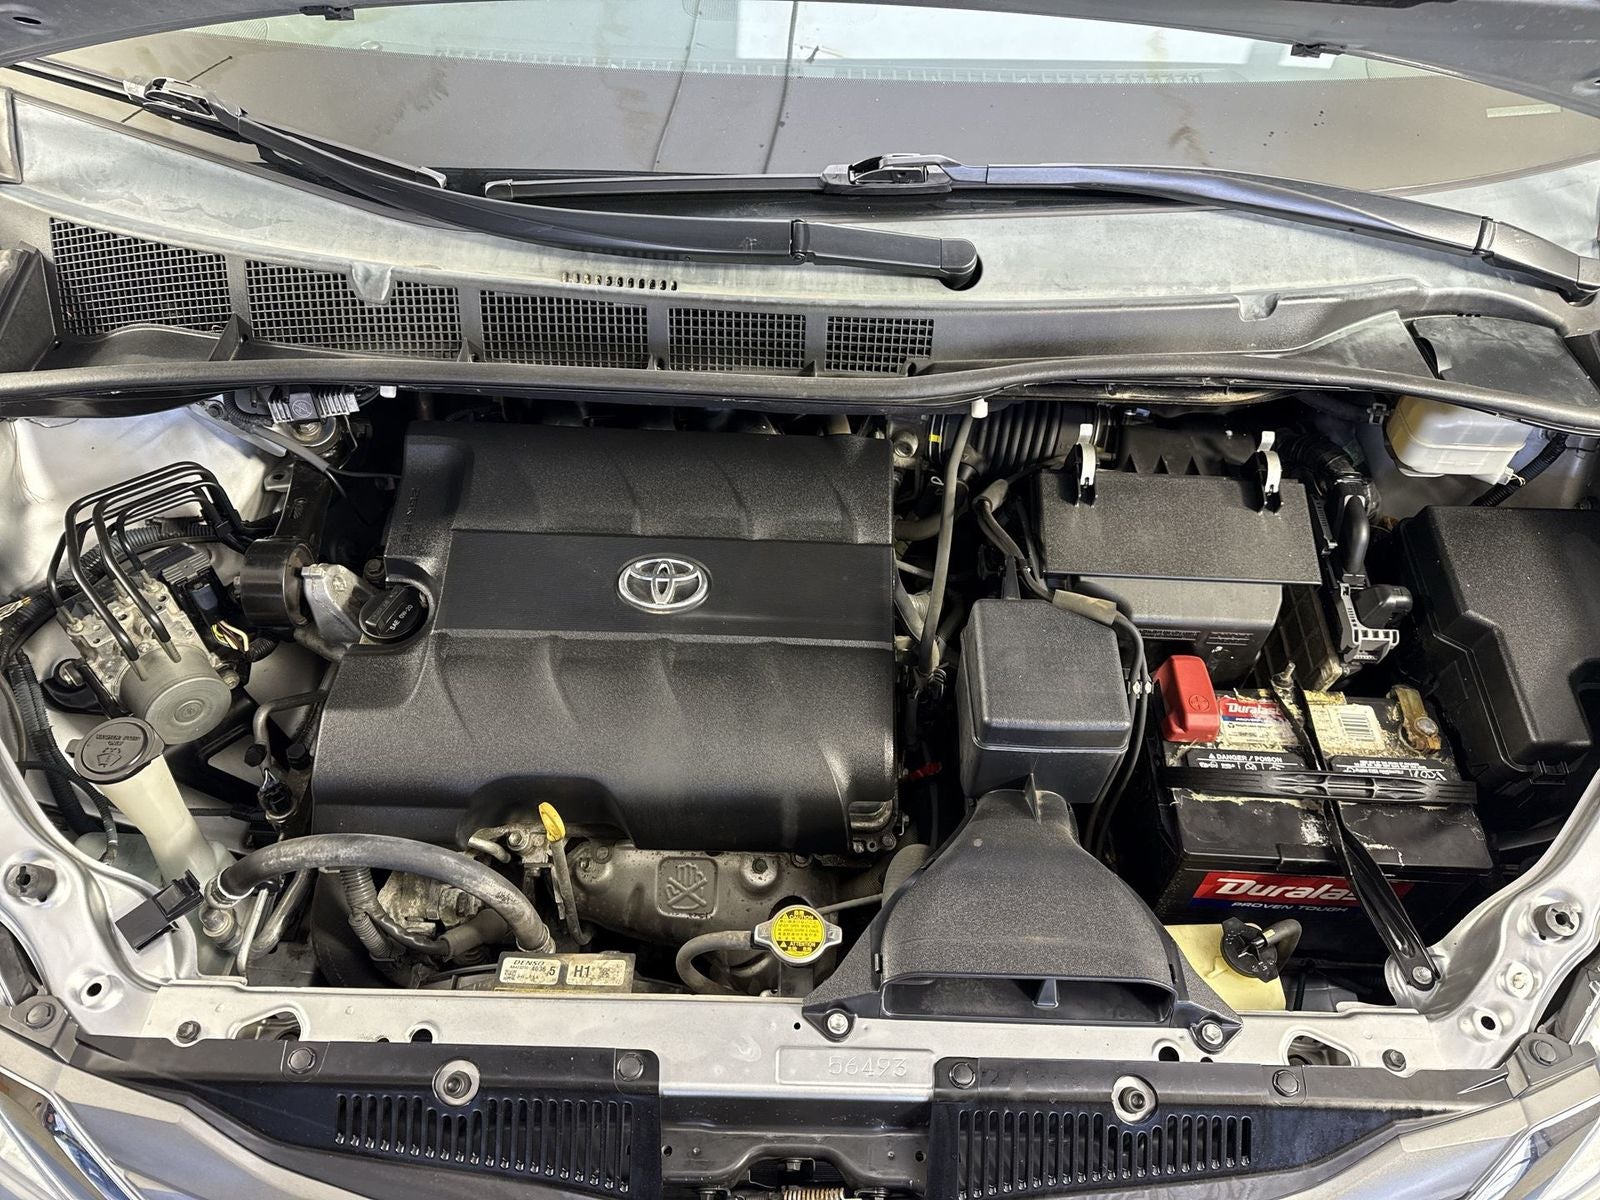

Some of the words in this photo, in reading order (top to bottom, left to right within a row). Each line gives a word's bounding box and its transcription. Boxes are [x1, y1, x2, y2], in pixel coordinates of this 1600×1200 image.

[389, 619, 401, 631] SAE
[1216, 753, 1248, 761] DANGER
[1215, 877, 1357, 901] Durala
[828, 1055, 908, 1077] 56493
